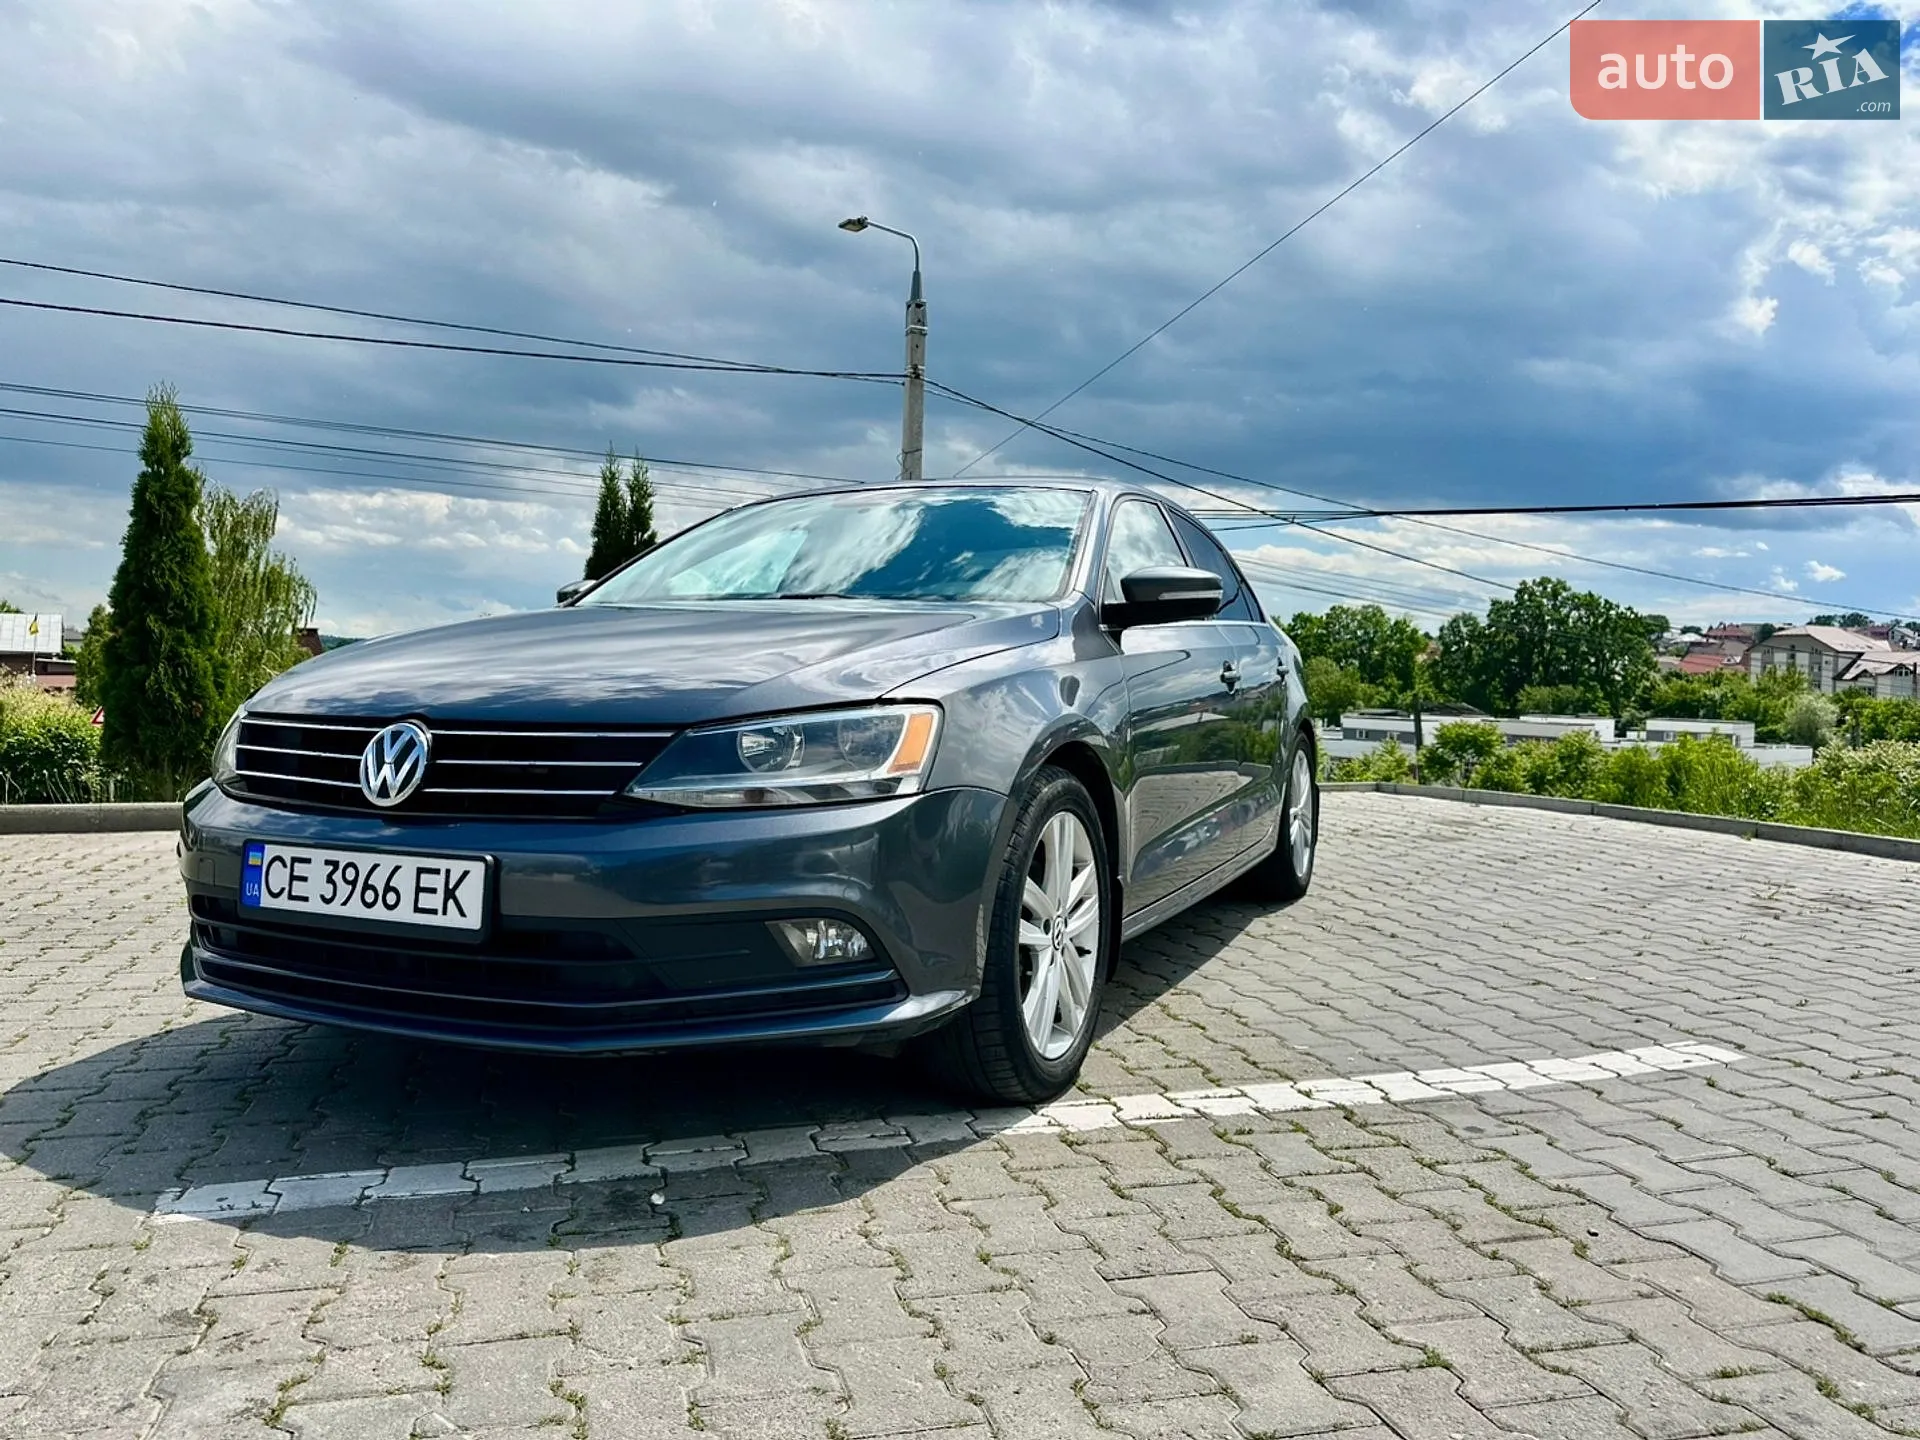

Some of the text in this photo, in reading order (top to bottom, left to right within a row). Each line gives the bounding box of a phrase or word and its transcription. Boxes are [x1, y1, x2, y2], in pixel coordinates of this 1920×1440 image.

[245, 883, 259, 896] UA
[265, 855, 471, 917] CE 3966 EK
